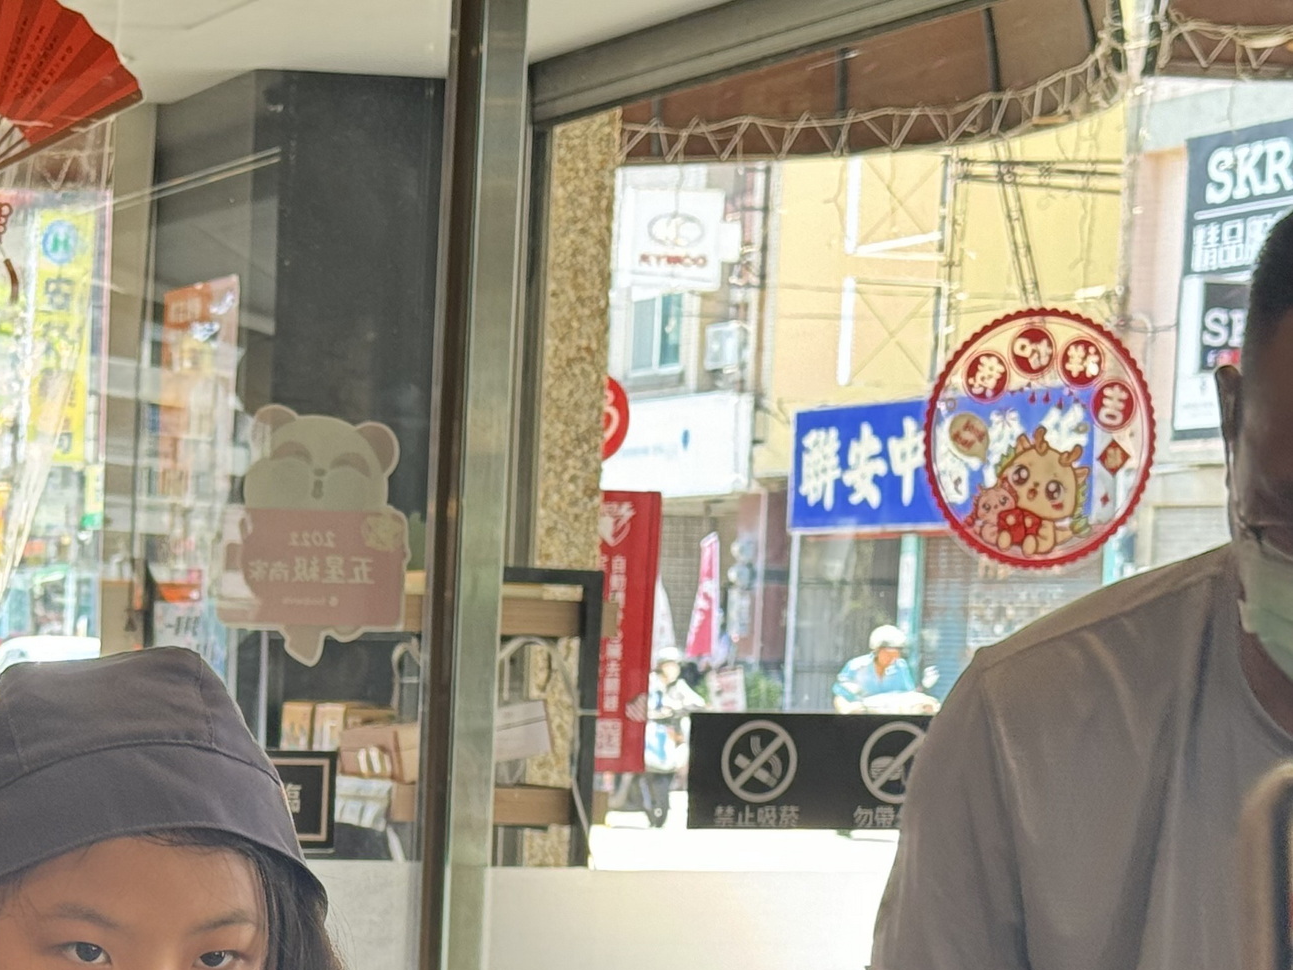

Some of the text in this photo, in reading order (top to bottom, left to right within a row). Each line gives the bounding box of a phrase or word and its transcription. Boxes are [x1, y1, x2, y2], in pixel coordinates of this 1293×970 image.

[713, 804, 801, 828] 禁止吸菸
[853, 803, 904, 829] 勿帶
